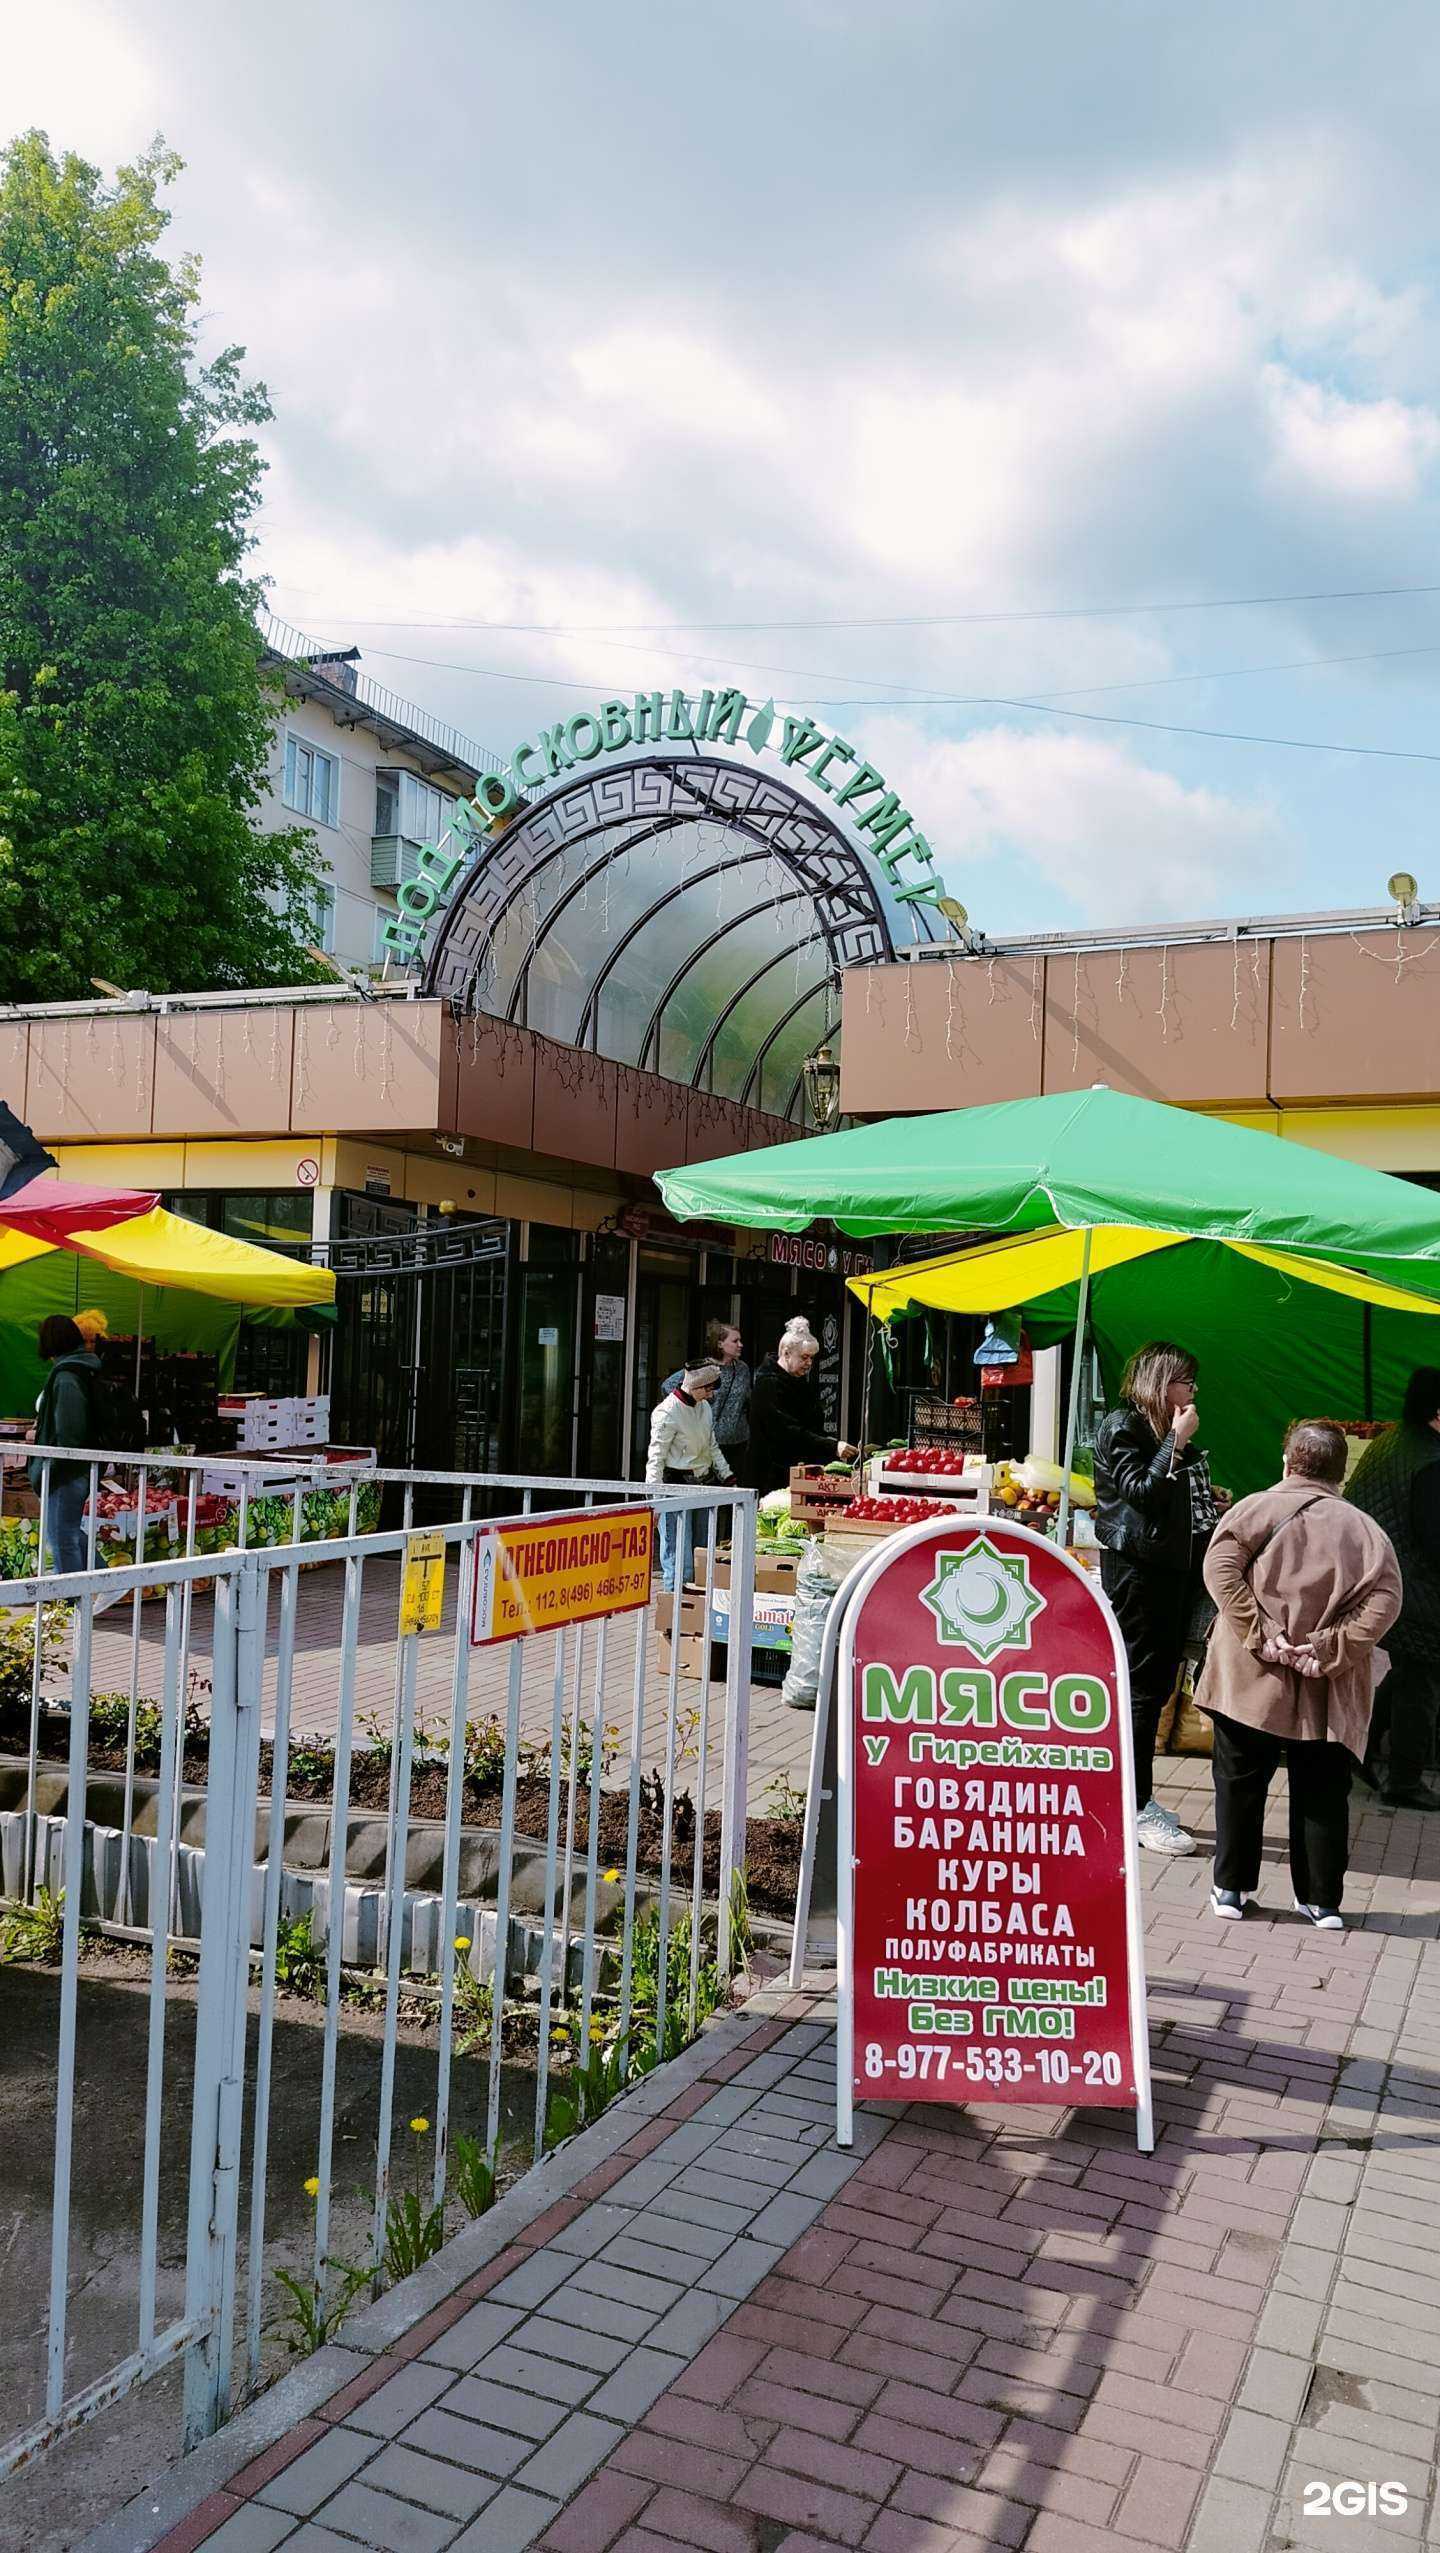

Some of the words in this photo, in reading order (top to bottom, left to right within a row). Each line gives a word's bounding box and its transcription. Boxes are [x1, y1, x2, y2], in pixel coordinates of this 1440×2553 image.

[380, 687, 748, 957] ПОДМОСКОВНЫЙ
[779, 716, 949, 907] ФЕРМЕР
[771, 1233, 827, 1269] МЯСО
[596, 1573, 646, 1597] 466-57-97
[754, 1609, 794, 1625] amat
[862, 1663, 1111, 1734] МЯСО
[863, 1735, 890, 1766] у
[908, 1732, 1114, 1772] Гирейхана
[894, 1776, 1084, 1818] ГОВЯДИНА
[893, 1816, 1086, 1856] БАРАНИНА
[938, 1858, 1041, 1895] КУРЫ
[906, 1898, 1075, 1937] КОЛБАСА
[885, 1938, 1095, 1967] ПОЛУФАБРИКАТЫ
[874, 1967, 999, 2002] Низкие
[1008, 1975, 1107, 2007] цены!
[908, 2002, 973, 2035] Без
[982, 2005, 1075, 2039] ГМО!
[865, 2042, 1122, 2086] 8-977-533-10-20
